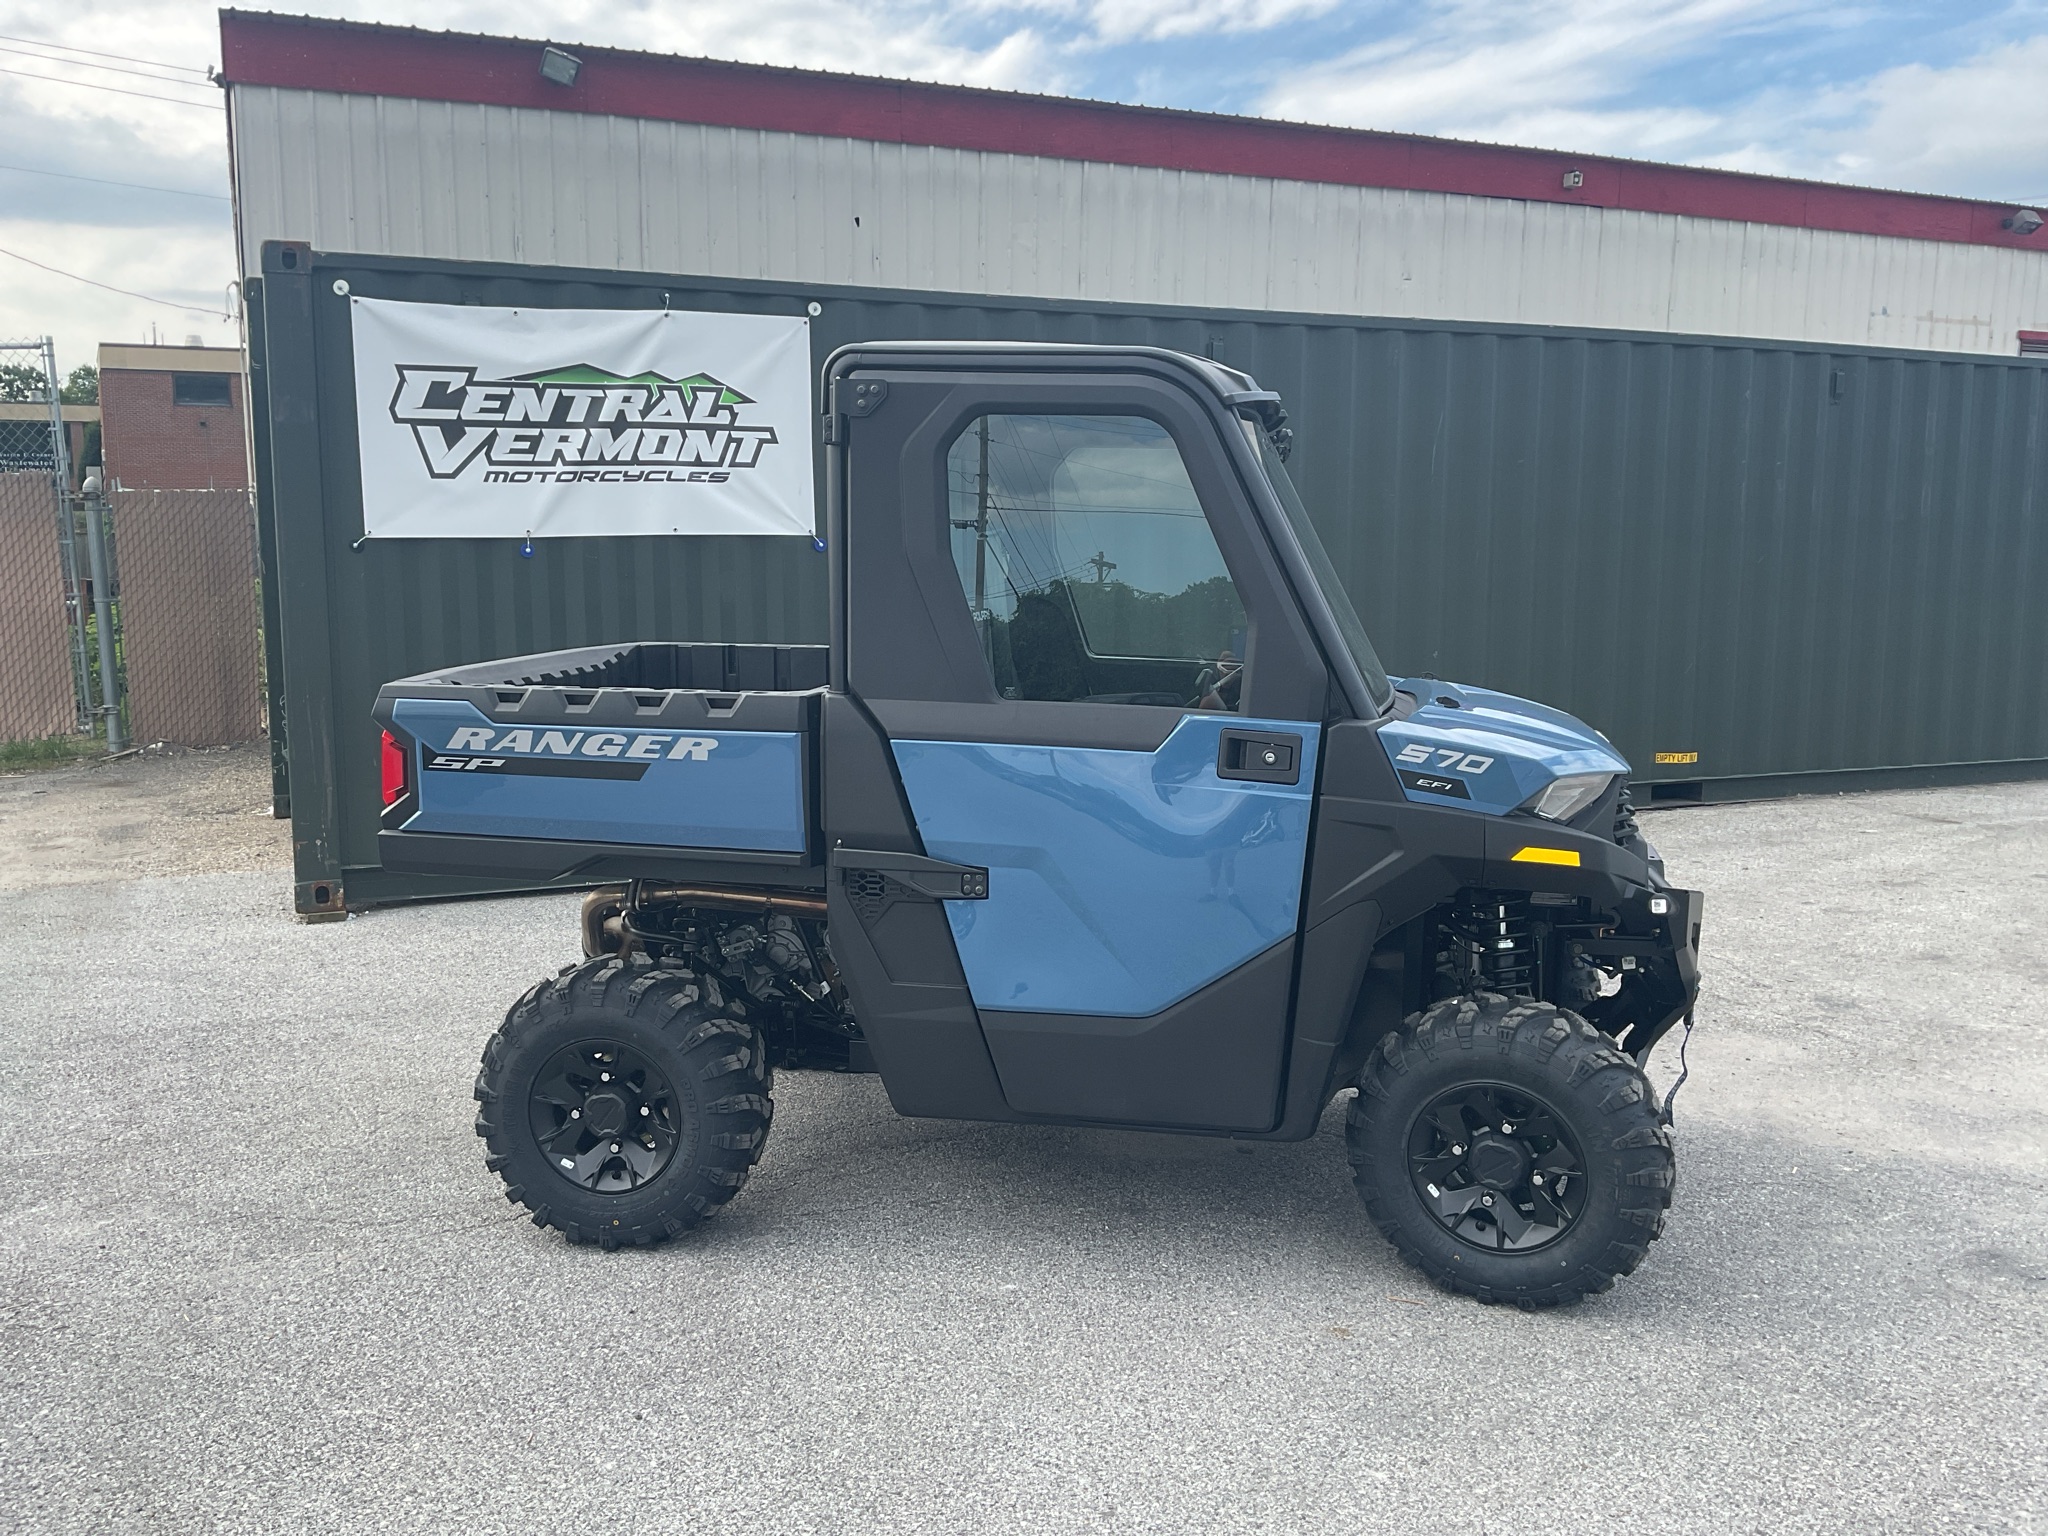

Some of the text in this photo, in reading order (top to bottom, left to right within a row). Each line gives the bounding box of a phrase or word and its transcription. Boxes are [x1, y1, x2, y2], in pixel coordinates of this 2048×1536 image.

[391, 364, 739, 423] CENTRAL
[411, 425, 777, 478] VERMONT
[483, 470, 731, 483] MOTORCYCLES
[446, 726, 719, 761] RANGER
[428, 756, 506, 771] SP
[1396, 743, 1494, 775] 570
[1657, 754, 1676, 762] EMPTY
[1677, 754, 1688, 762] LIFT
[1416, 778, 1452, 791] EFI
